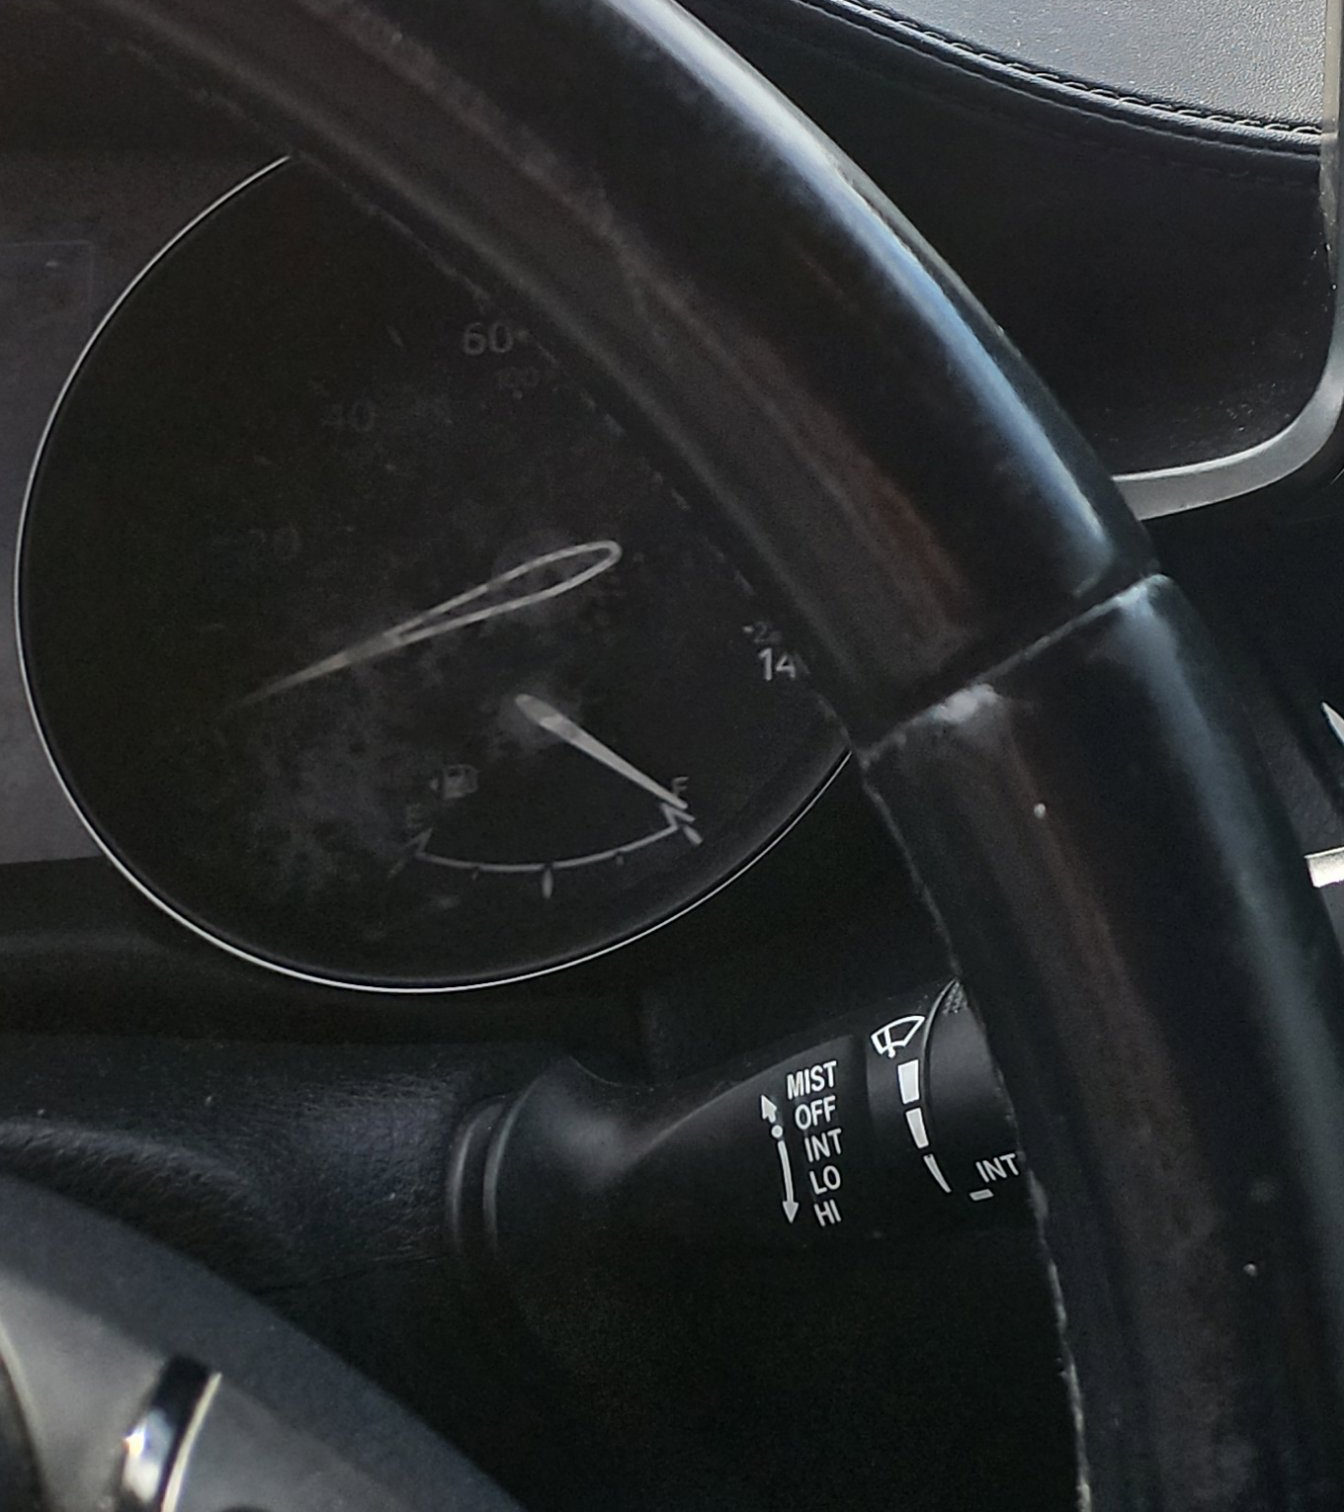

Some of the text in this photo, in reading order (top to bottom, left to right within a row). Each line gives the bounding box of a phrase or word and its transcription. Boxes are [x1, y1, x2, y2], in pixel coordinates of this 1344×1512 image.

[757, 647, 802, 682] 14
[786, 1060, 838, 1100] MIST
[794, 1095, 837, 1130] OFF
[804, 1128, 842, 1163] INT
[809, 1165, 842, 1196] LO
[974, 1152, 1022, 1183] INT
[813, 1199, 842, 1227] HI
